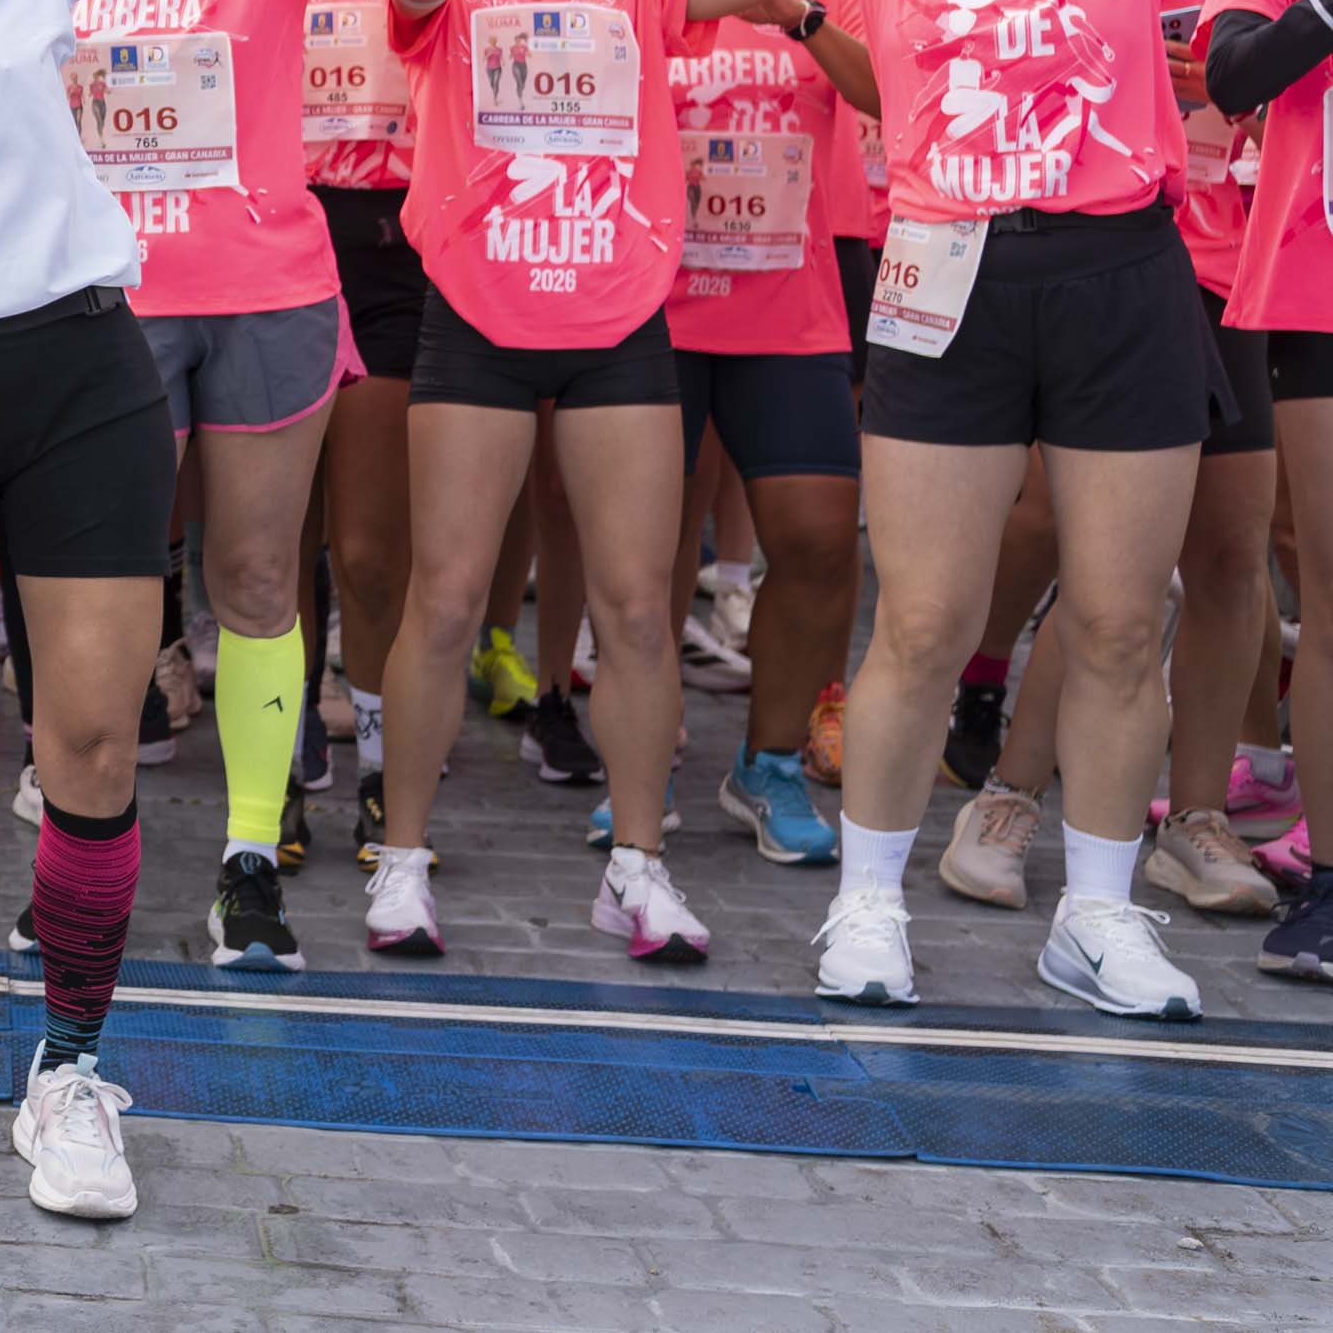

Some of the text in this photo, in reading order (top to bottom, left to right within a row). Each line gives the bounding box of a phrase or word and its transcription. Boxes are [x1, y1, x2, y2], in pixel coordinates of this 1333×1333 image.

[309, 65, 367, 88] 016
[668, 50, 798, 87] ARRERA
[534, 71, 596, 96] 016
[550, 101, 581, 113] 3155
[113, 107, 178, 132] 016
[135, 137, 159, 149] 765
[105, 153, 115, 162] DE
[117, 152, 127, 162] LA
[129, 152, 158, 162] MUJER
[165, 151, 189, 161] GRAN
[190, 150, 228, 160] CANARIA
[931, 148, 1072, 202] MUJER
[708, 195, 766, 217] 016
[486, 216, 614, 264] MUJER
[529, 268, 577, 294] 2026
[688, 274, 731, 296] 2026
[879, 258, 919, 289] 016
[881, 289, 904, 304] 2270
